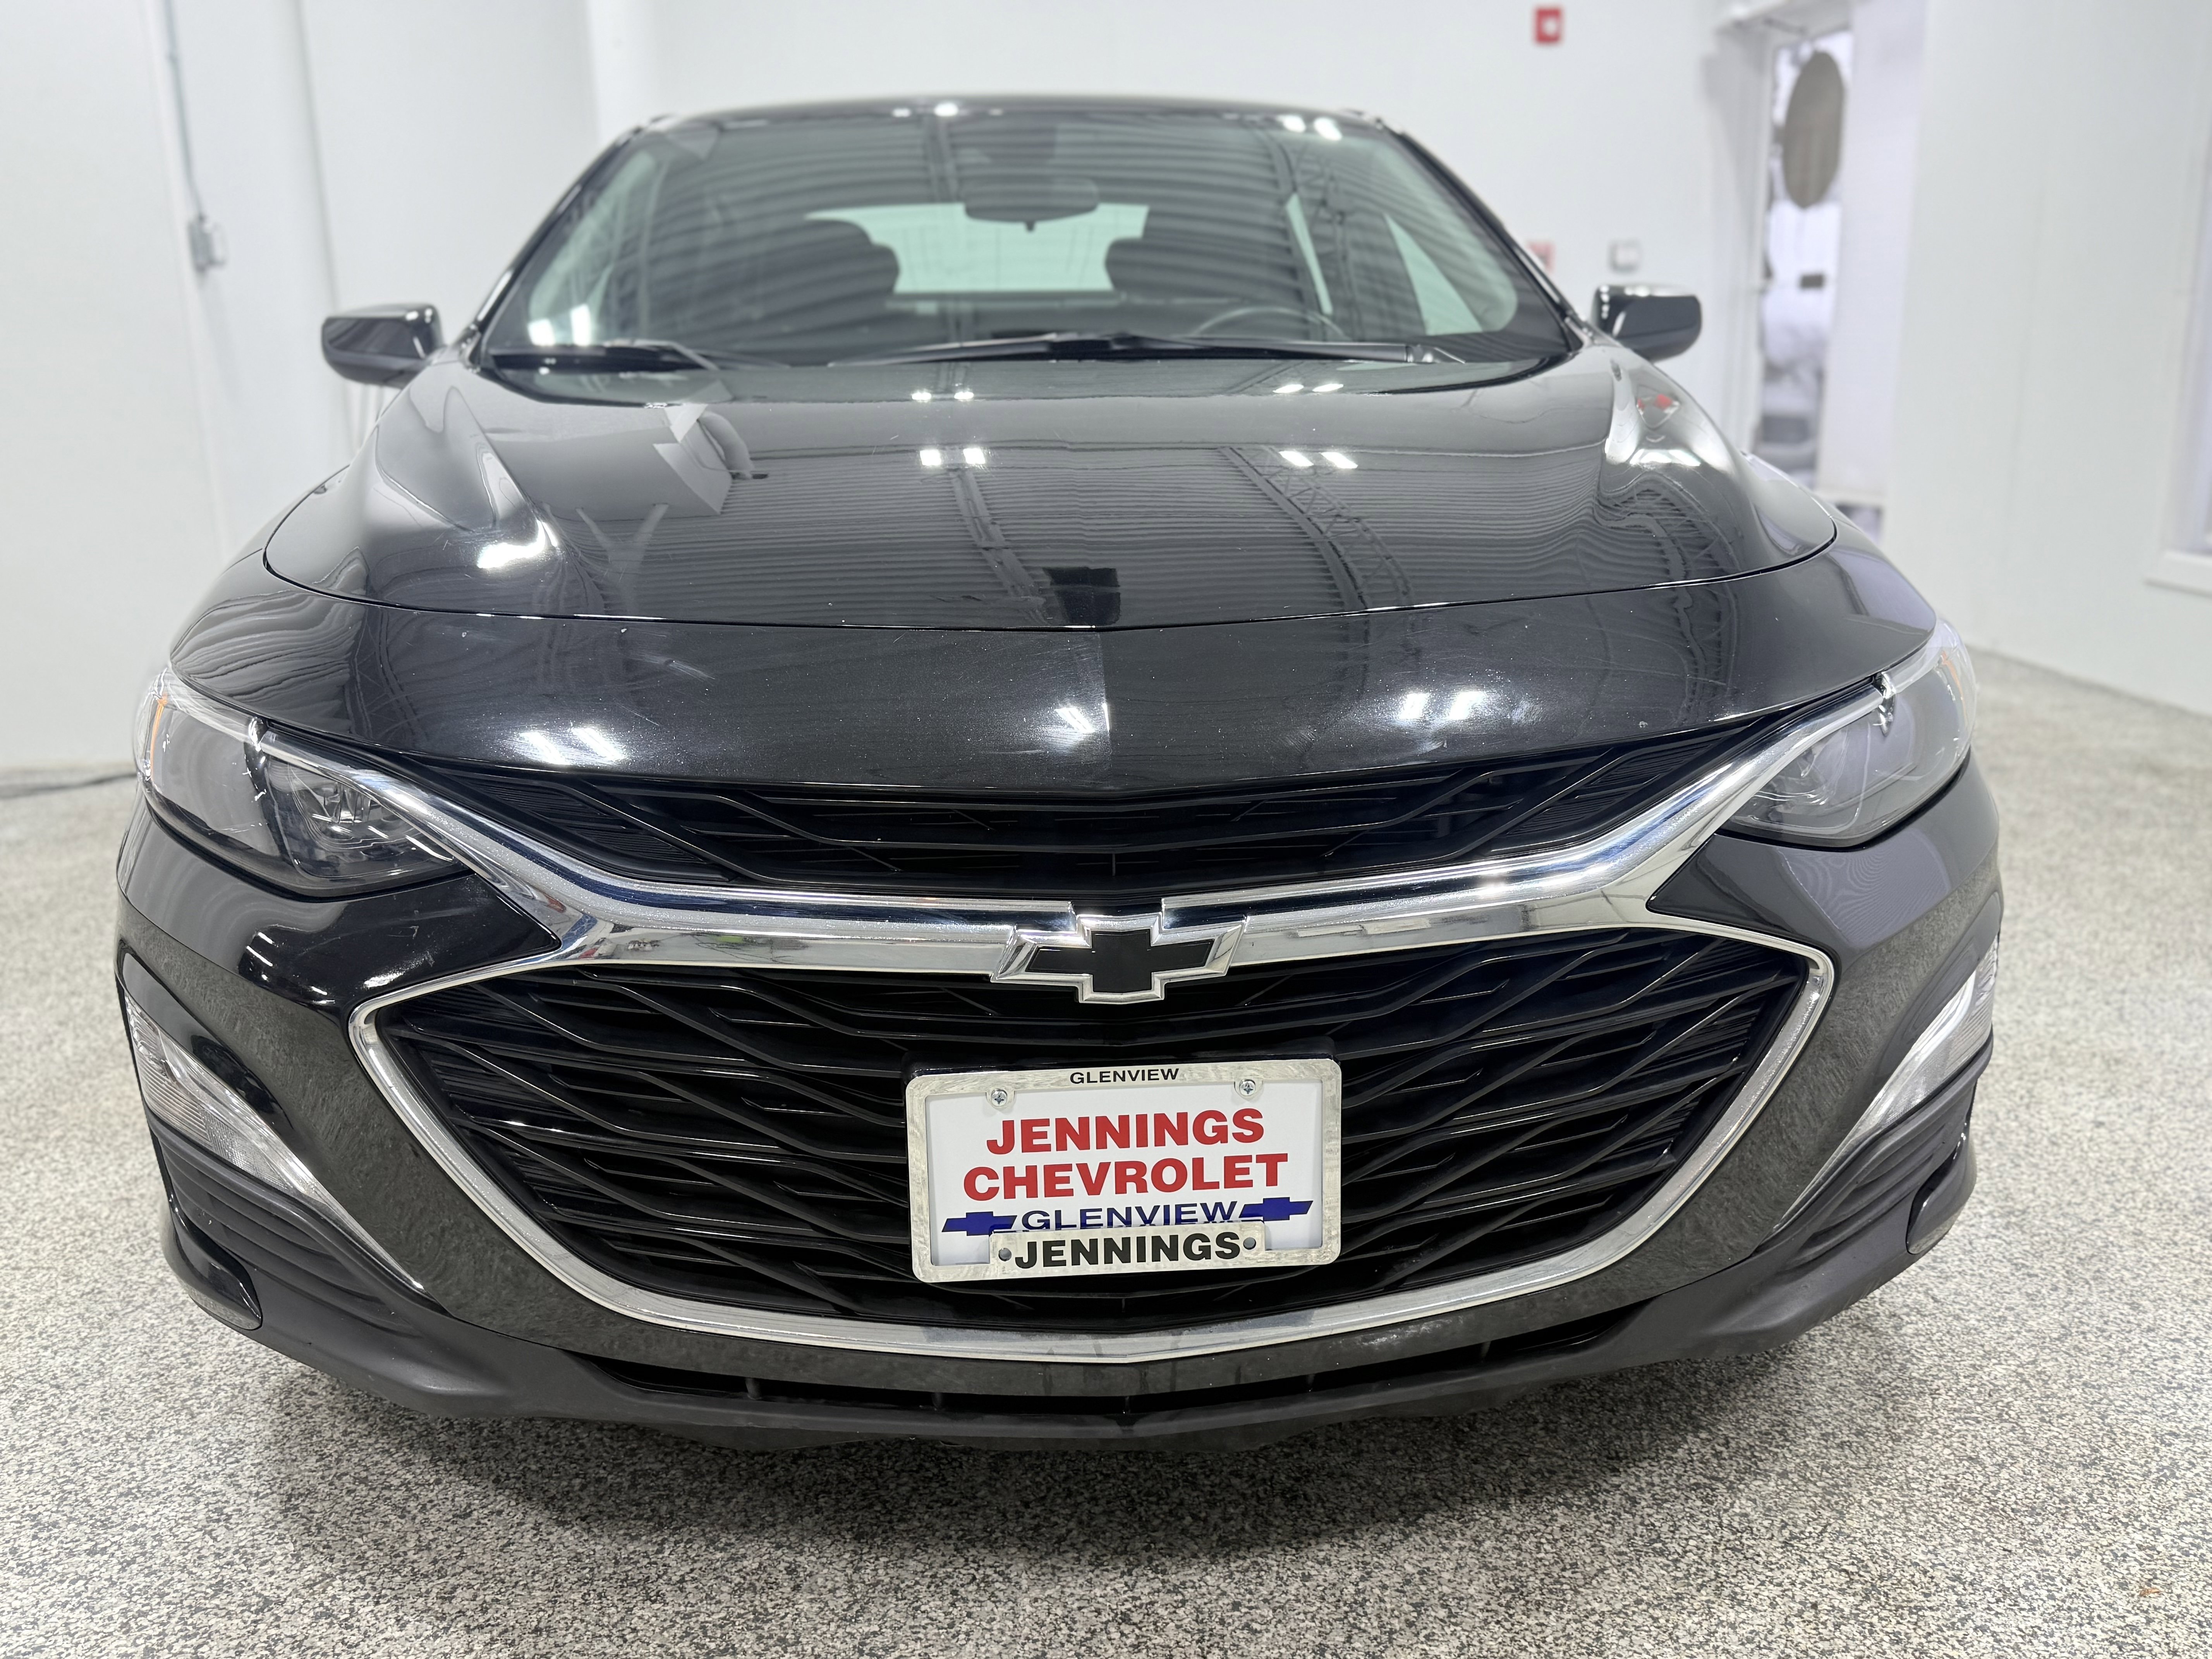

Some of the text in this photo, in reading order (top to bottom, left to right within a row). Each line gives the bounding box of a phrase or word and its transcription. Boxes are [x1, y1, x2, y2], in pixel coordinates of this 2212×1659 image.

[1070, 1068, 1179, 1084] GLENVIEW
[987, 1108, 1264, 1154] JENNINGS
[964, 1153, 1288, 1201] CHEVROLET
[1021, 1201, 1238, 1230] GLENVIEW
[1015, 1231, 1240, 1269] JENNINGS
